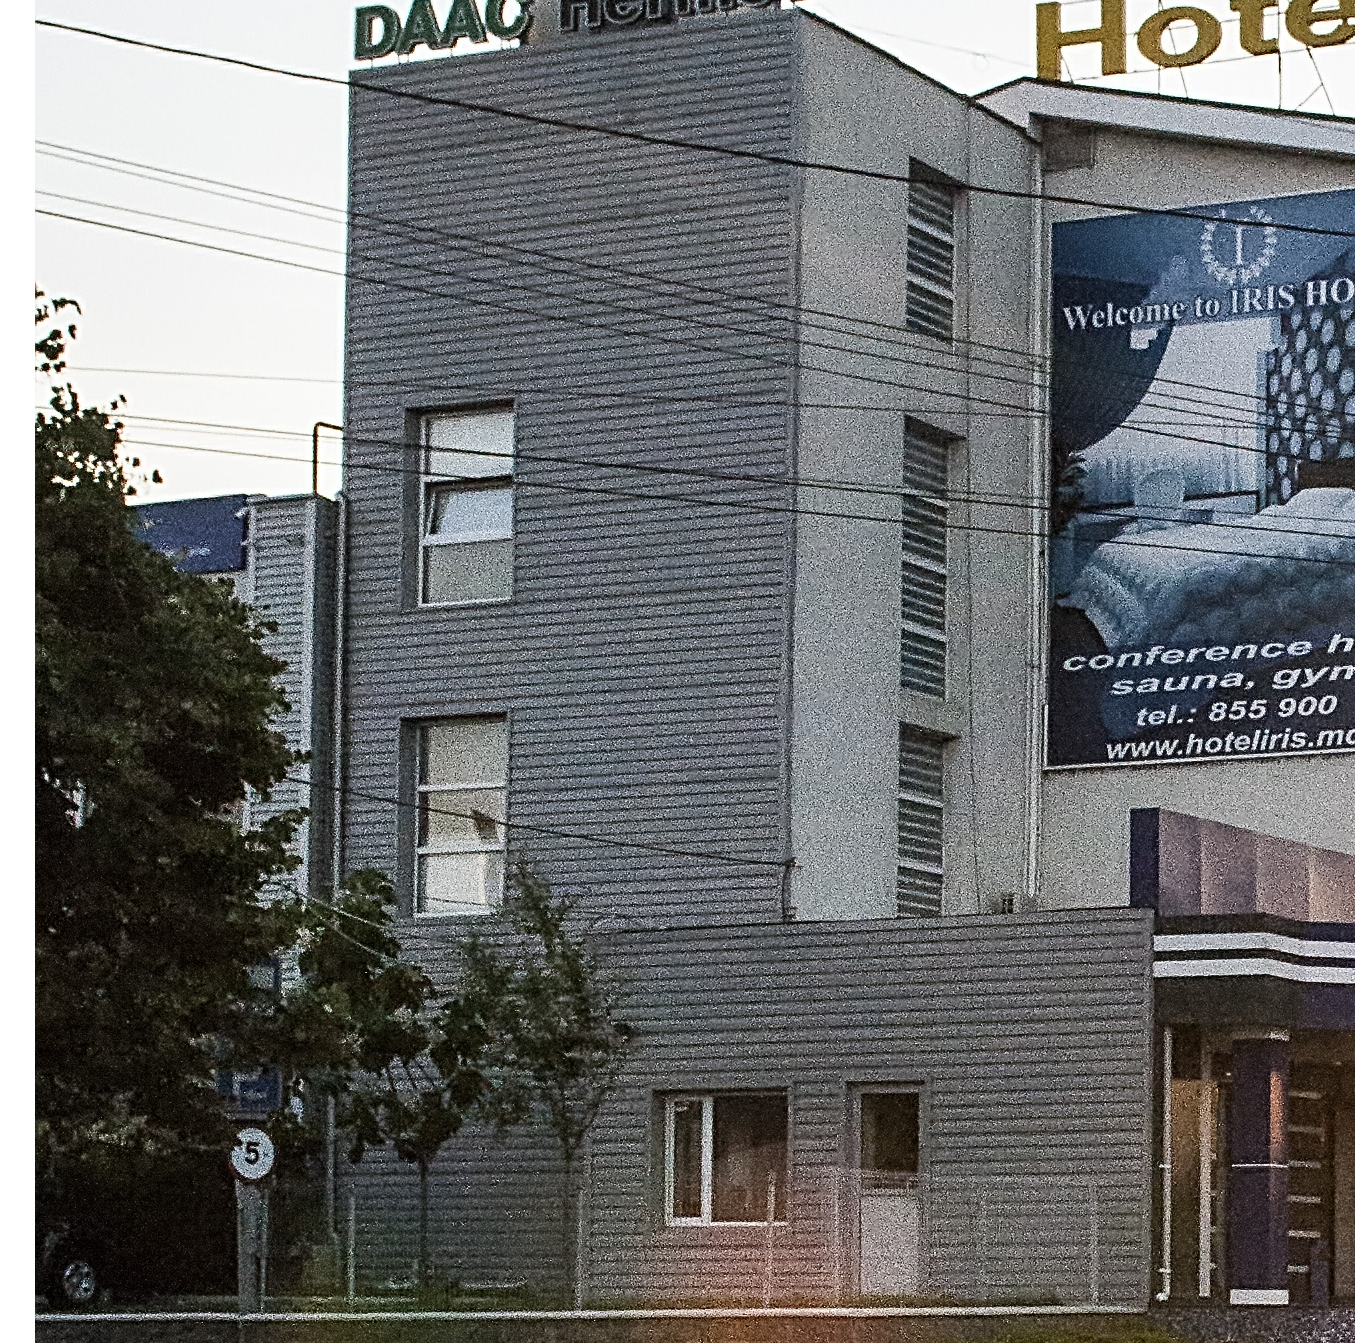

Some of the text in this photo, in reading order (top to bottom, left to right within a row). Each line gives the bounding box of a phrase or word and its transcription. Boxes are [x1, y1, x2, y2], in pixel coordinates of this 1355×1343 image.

[1063, 301, 1187, 331] Welcome
[1193, 296, 1221, 318] to
[1230, 284, 1296, 315] IRIS
[1062, 639, 1313, 673] conference
[1110, 671, 1256, 696] sauna,
[1135, 694, 1339, 727] tel.: 855 900
[244, 1142, 260, 1165] 5
